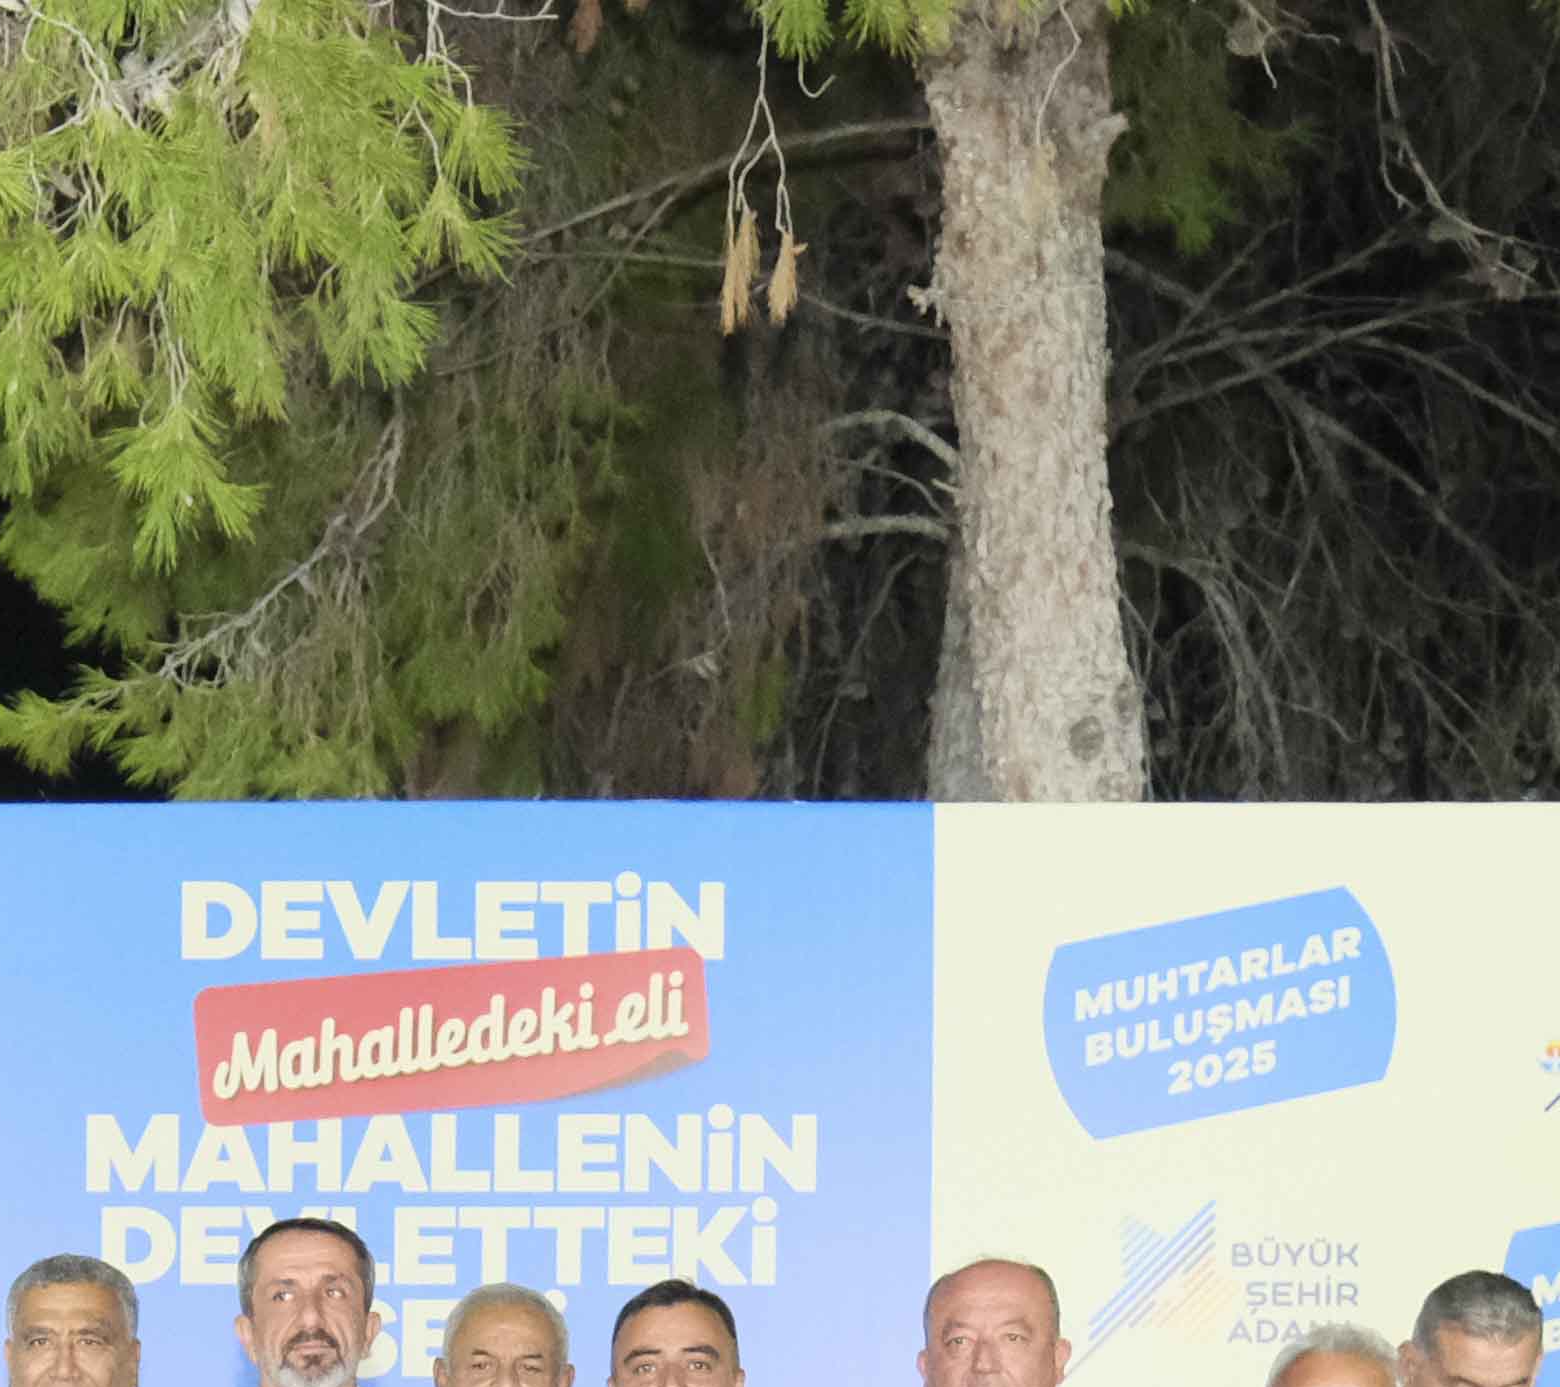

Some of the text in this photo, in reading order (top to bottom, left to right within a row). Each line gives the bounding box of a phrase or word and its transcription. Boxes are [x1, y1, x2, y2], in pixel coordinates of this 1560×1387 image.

[1074, 927, 1361, 1021] MUHTARLAR
[212, 970, 688, 1099] Mahalledeki eli
[1085, 976, 1350, 1066] BULUŞMASI
[1168, 1040, 1276, 1095] 2025
[1232, 1236, 1359, 1267] BÜYÜK
[1246, 1275, 1359, 1315] ŞEHİR
